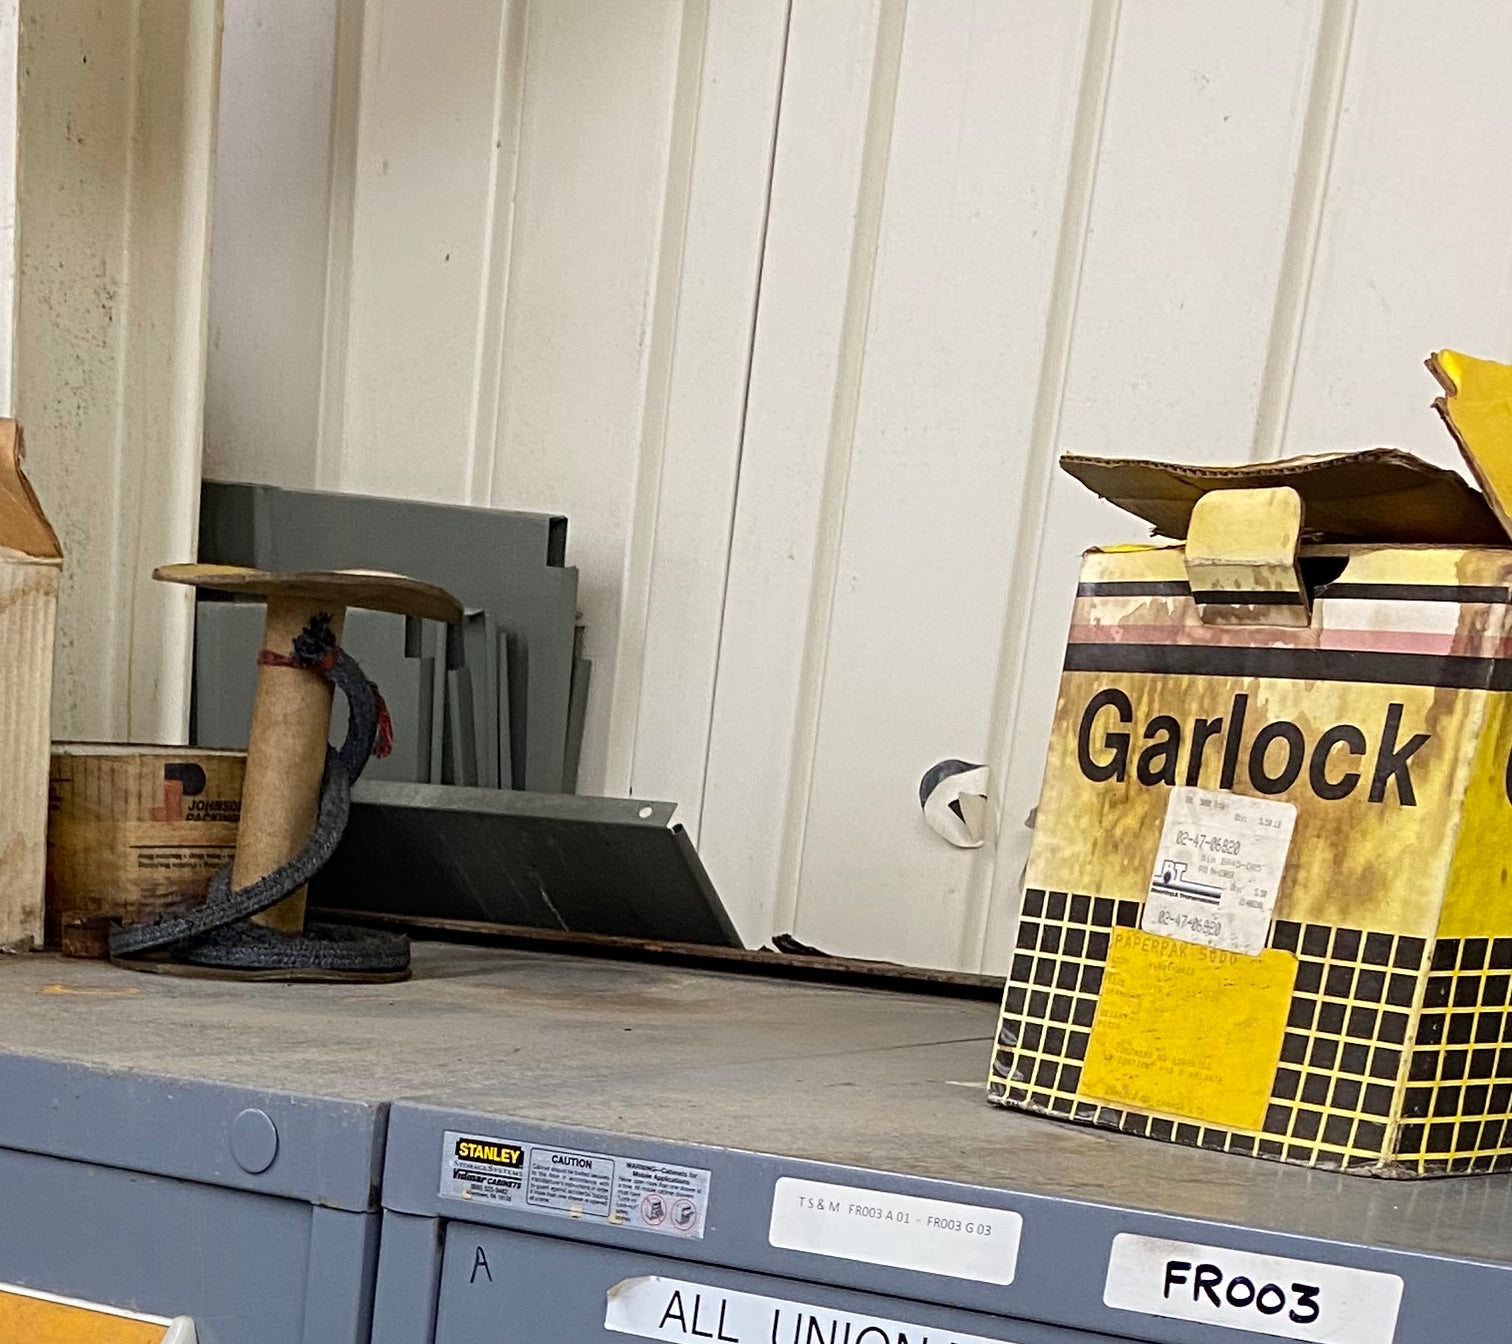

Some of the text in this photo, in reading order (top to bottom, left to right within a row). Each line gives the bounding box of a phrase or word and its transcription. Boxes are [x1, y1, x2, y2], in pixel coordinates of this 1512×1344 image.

[1077, 688, 1433, 807] Garlock
[458, 1142, 521, 1164] STANLEY
[551, 1154, 593, 1169] CAUTION
[848, 1204, 883, 1220] FR003
[885, 1210, 893, 1222] A
[896, 1212, 910, 1225] 01
[926, 1216, 962, 1232] FR003
[965, 1222, 974, 1234] G
[977, 1224, 992, 1236] 03
[469, 1245, 493, 1284] A
[1163, 1260, 1321, 1324] FR003
[659, 1289, 740, 1343] ALL
